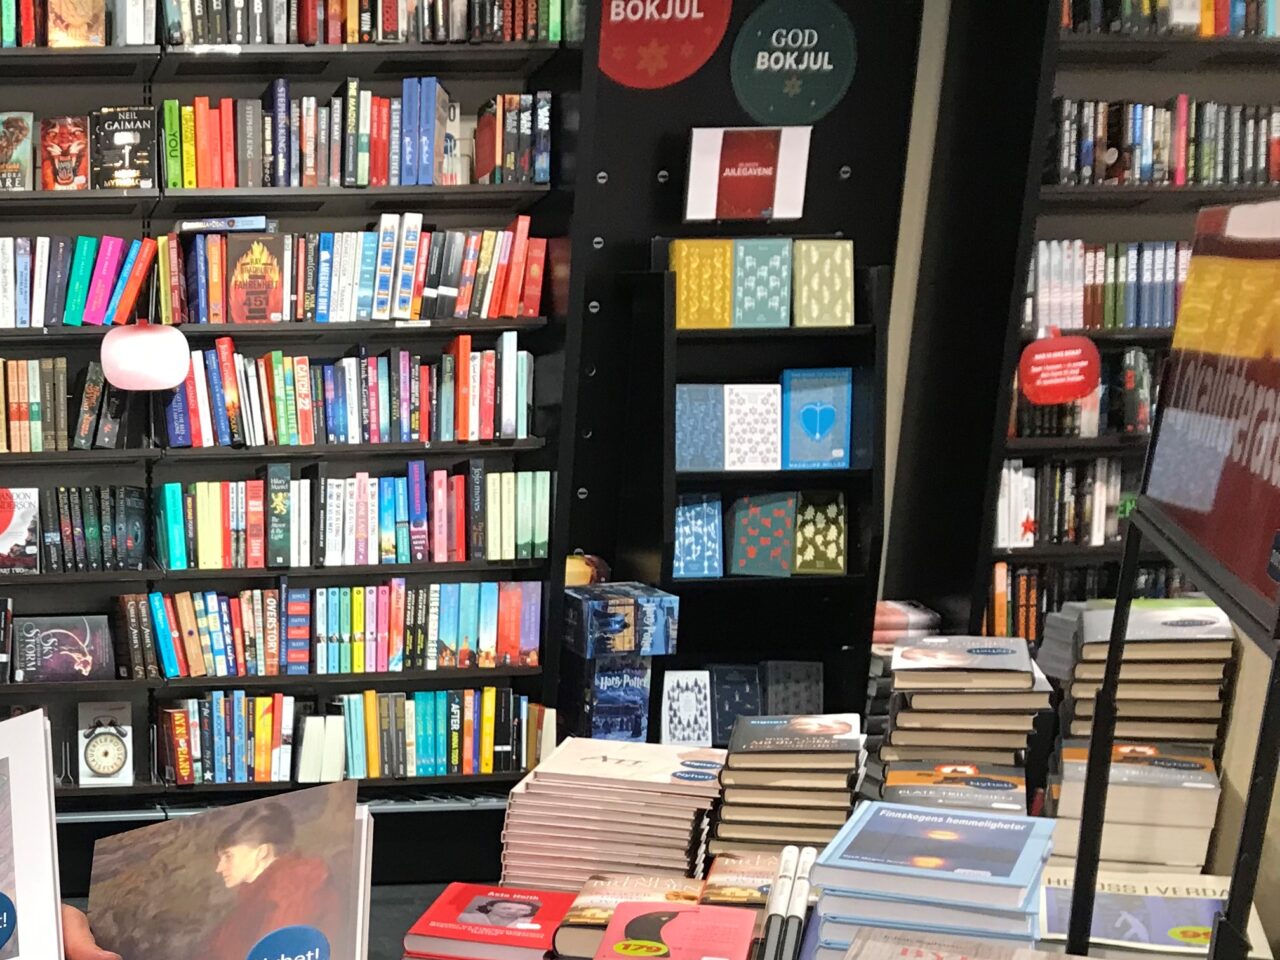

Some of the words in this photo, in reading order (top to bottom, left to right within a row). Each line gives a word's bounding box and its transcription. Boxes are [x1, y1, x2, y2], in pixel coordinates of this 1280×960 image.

[610, 0, 704, 21] BOKJUL
[772, 28, 818, 47] GOD
[755, 51, 834, 71] BOKJUL
[118, 112, 137, 120] NEIL
[277, 83, 287, 131] STEPHEN
[104, 120, 151, 131] GAIMAN
[169, 131, 178, 159] YOU
[321, 258, 330, 294] AMERICAN
[296, 364, 312, 411] CATCH-22
[266, 598, 278, 654] OVERSTORY
[600, 673, 623, 690] Harry
[623, 675, 649, 689] Potter
[173, 712, 185, 736] AYN
[450, 703, 460, 730] AFTER
[879, 808, 944, 824] Finnskogens
[945, 816, 1028, 832] hemmeligheter
[620, 942, 660, 955] 179
